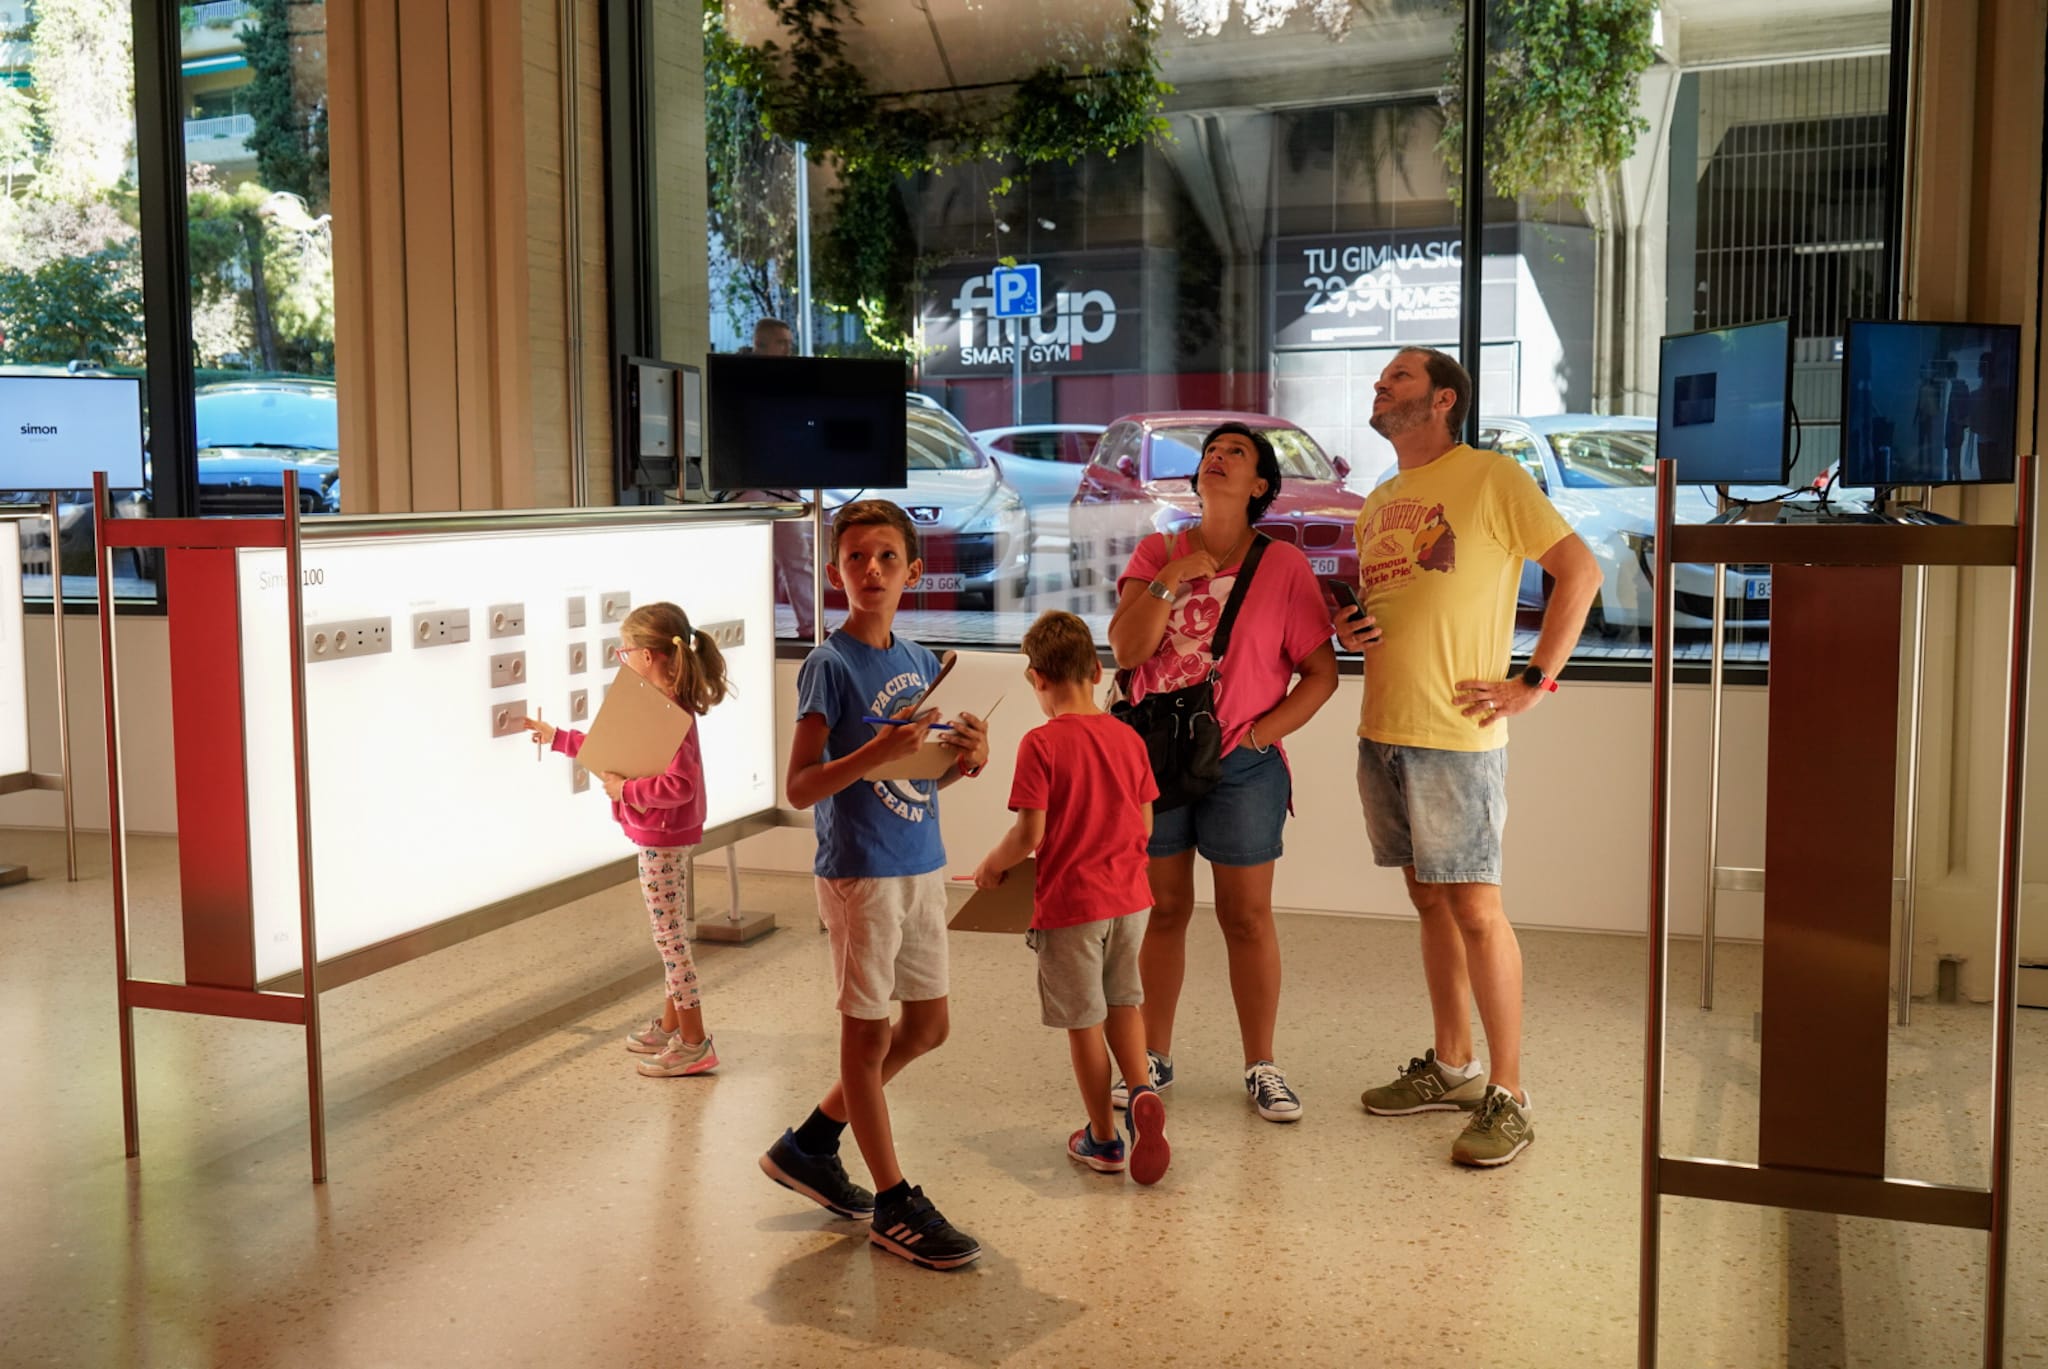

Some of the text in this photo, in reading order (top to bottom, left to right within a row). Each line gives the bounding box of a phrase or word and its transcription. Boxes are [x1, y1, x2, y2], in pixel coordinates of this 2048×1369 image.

[1303, 248, 1337, 275] TU
[1000, 272, 1028, 313] P
[1029, 343, 1071, 363] GYM
[20, 422, 58, 435] simon
[258, 568, 324, 590] Sim 100
[937, 577, 963, 590] GGK
[871, 671, 922, 717] PACIFIC
[873, 780, 924, 823] CEAN
